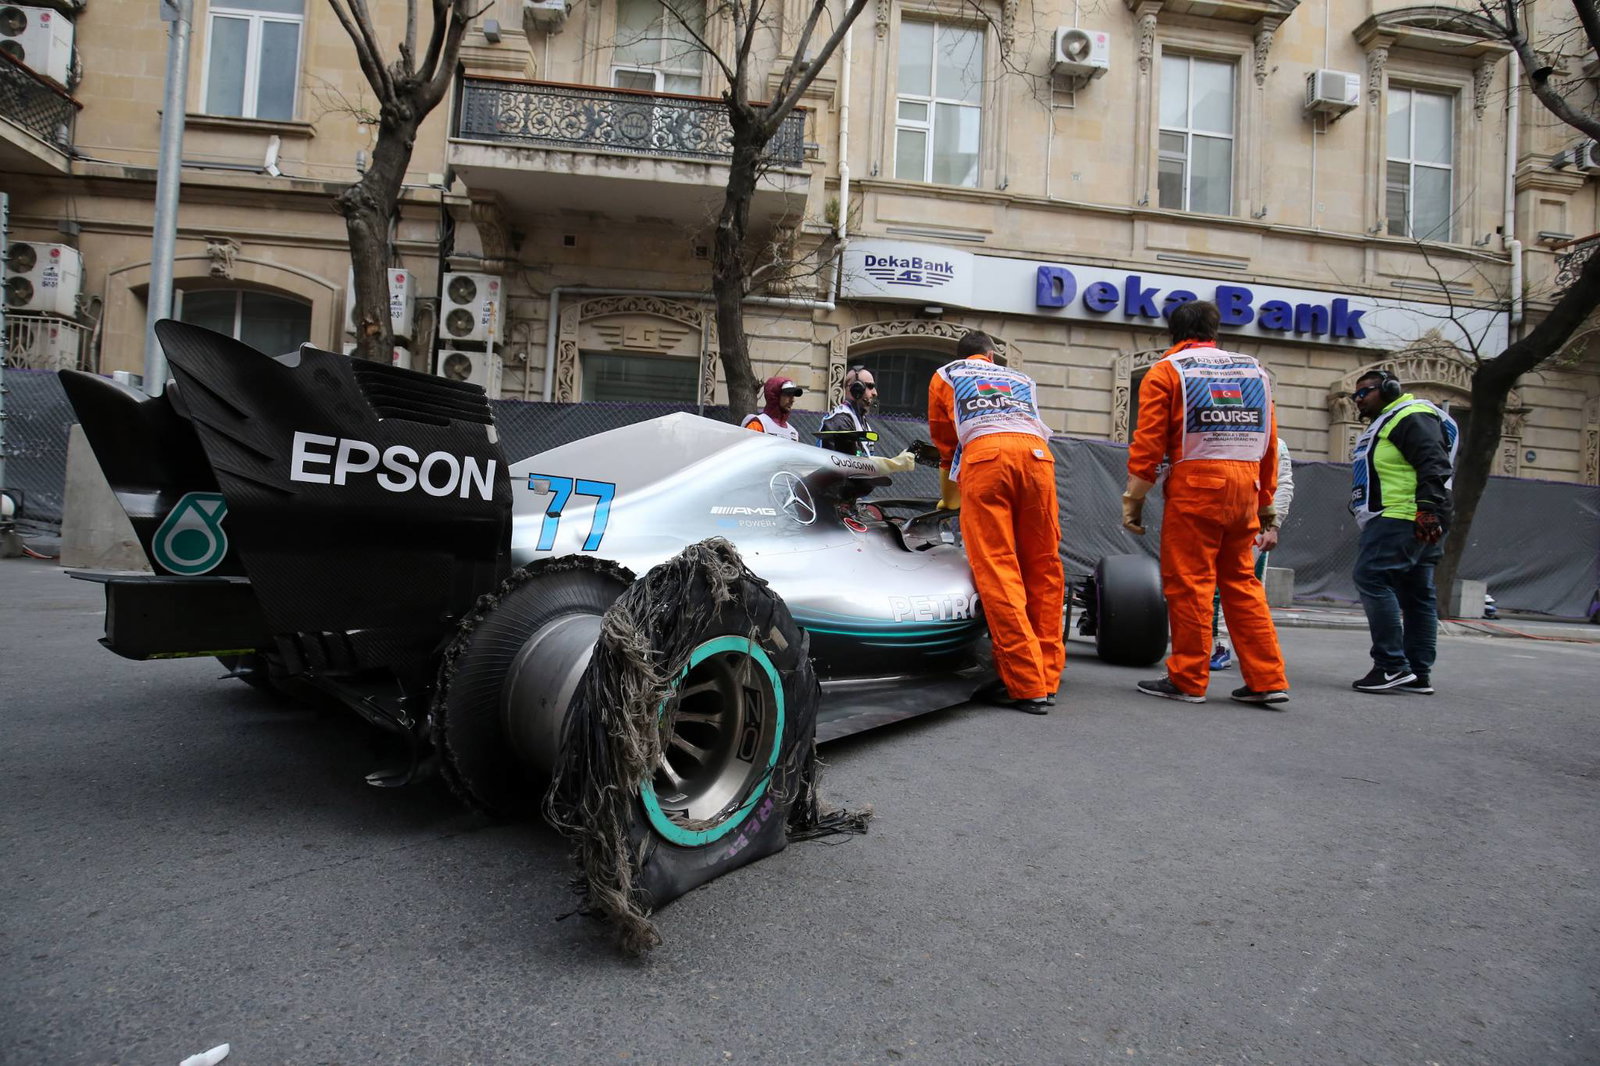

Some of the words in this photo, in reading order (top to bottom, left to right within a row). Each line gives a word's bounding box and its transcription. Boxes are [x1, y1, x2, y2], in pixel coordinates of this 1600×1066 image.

[864, 254, 954, 274] DekaBank
[1436, 360, 1473, 391] BAN
[966, 397, 1030, 412] COURSE
[1200, 410, 1258, 423] COURSE
[290, 431, 497, 501] EPSON
[831, 455, 876, 472] Qualcomm
[528, 472, 616, 551] 77
[732, 506, 777, 516] AMG
